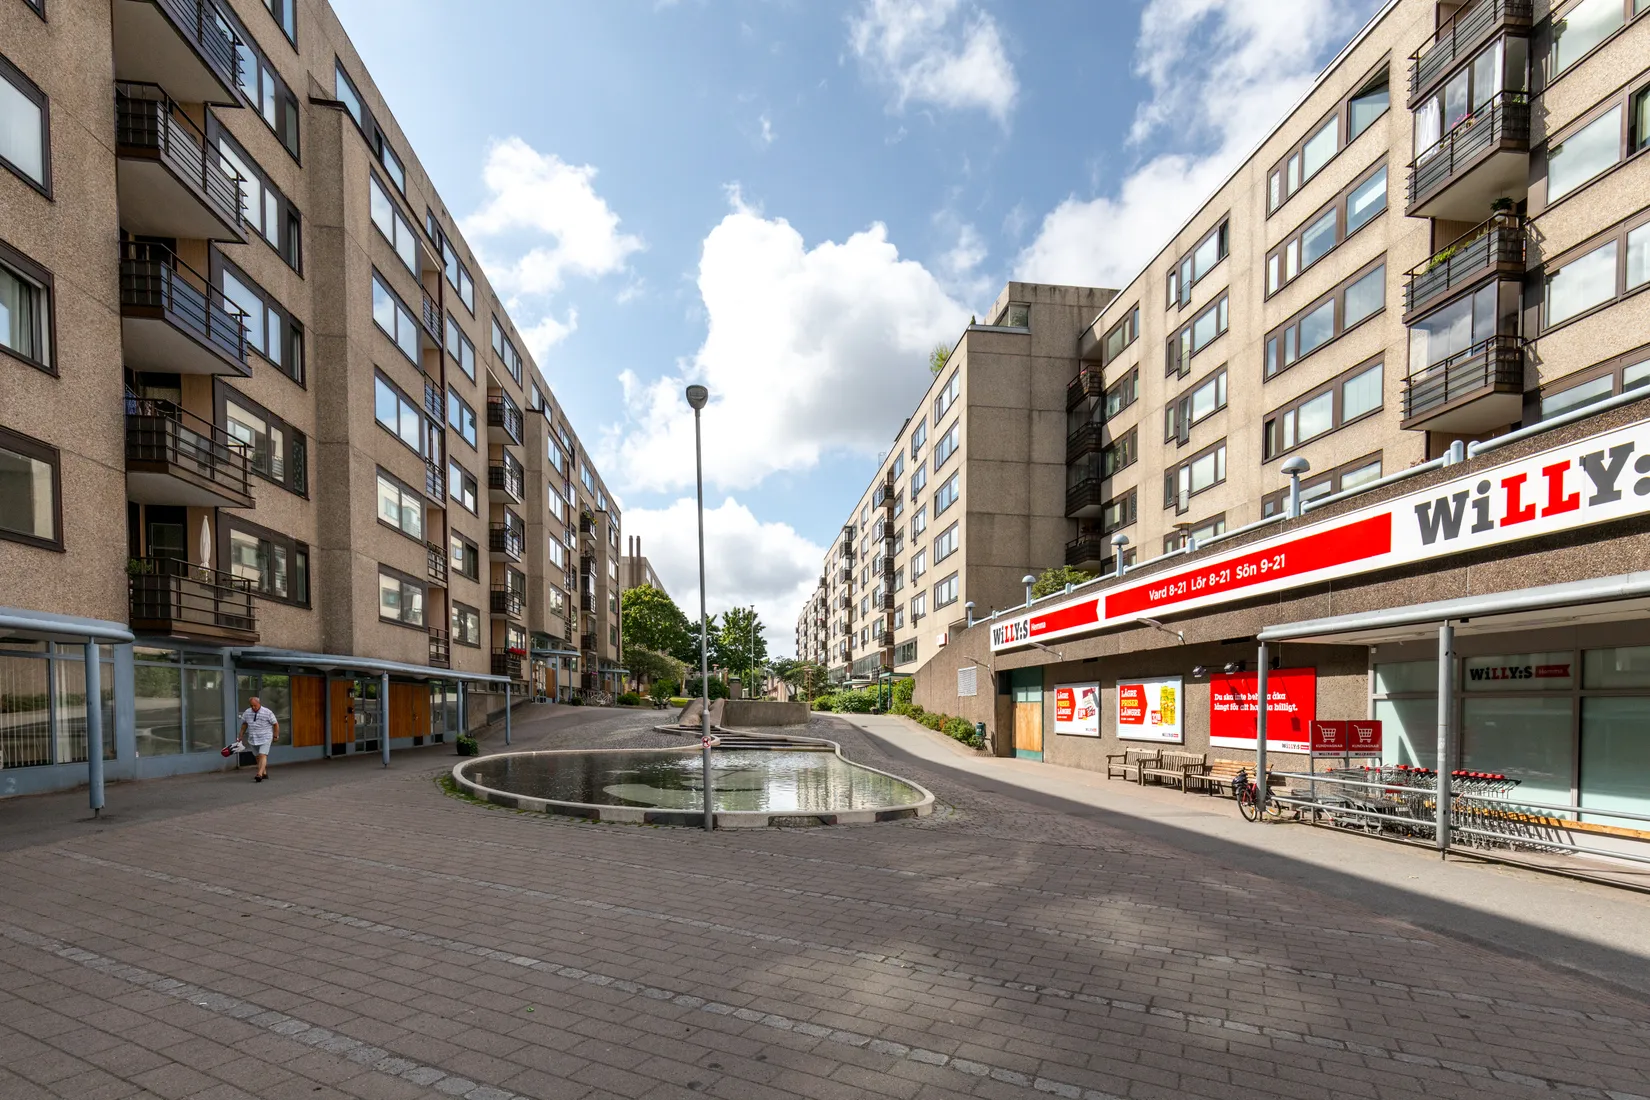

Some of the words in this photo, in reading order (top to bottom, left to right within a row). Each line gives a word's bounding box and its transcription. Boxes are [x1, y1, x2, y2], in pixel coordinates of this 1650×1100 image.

[1149, 586, 1167, 601] Vard
[1169, 581, 1187, 596] 8-21
[1191, 575, 1207, 591] Lör
[1209, 569, 1230, 586] 8-21
[1236, 564, 1257, 579] Sön
[1260, 554, 1286, 573] 9-21
[993, 620, 1028, 646] WiLLY:S
[1470, 666, 1532, 681] WiLLY:S
[1234, 692, 1246, 700] inte
[1247, 692, 1271, 700] beha
[1272, 691, 1286, 700] åka
[1214, 702, 1230, 712] långt
[1230, 702, 1239, 711] för
[1240, 703, 1249, 711] att
[1249, 703, 1273, 711] hala
[1274, 702, 1298, 712] billigt.
